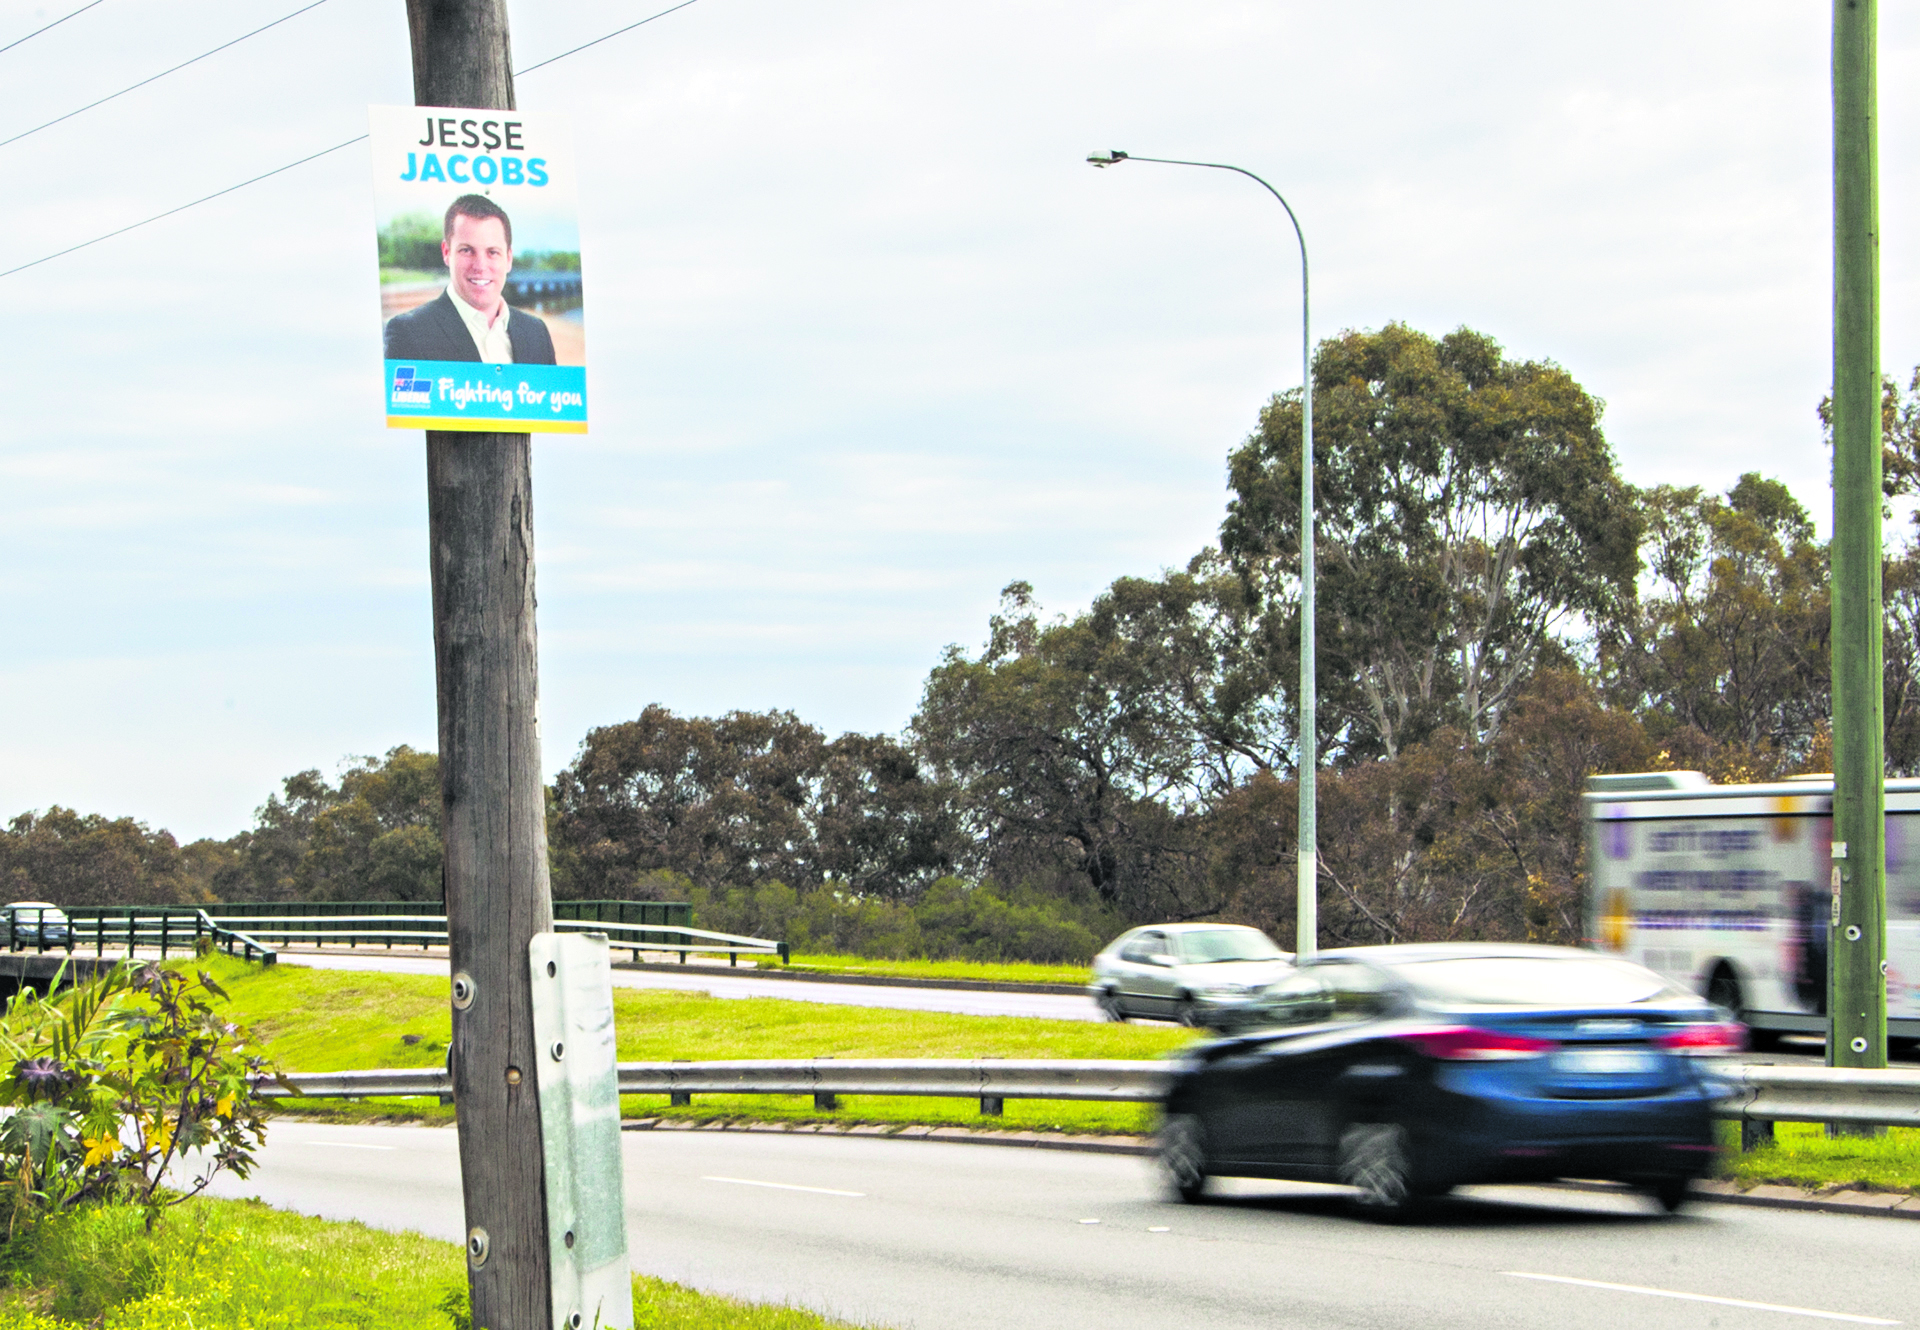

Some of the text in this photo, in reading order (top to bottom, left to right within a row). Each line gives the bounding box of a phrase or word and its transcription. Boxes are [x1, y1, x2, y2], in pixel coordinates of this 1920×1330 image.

[419, 117, 525, 151] JESSE
[400, 152, 549, 187] JACOBS
[438, 377, 583, 413] Fighting for you
